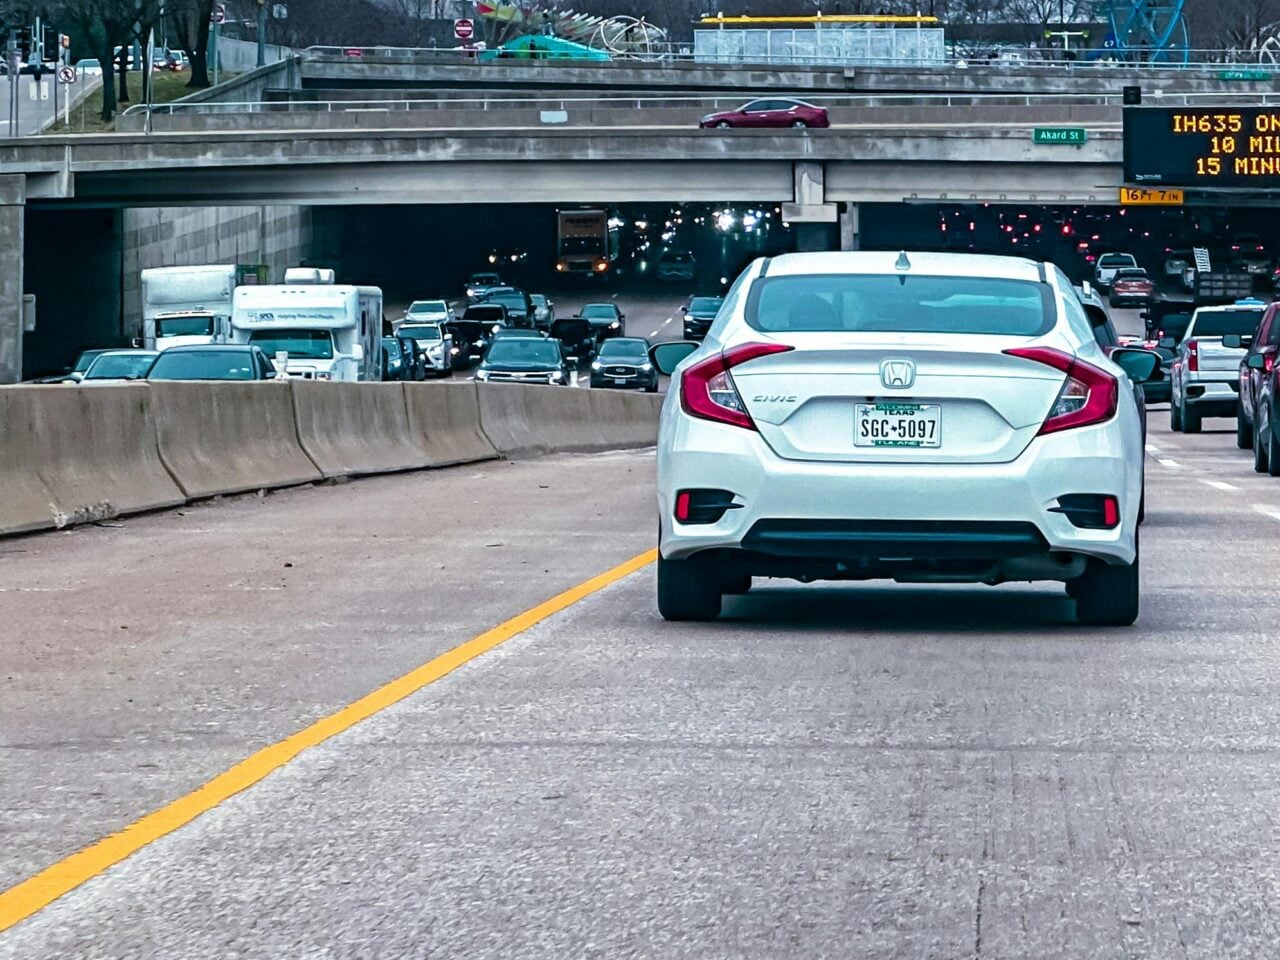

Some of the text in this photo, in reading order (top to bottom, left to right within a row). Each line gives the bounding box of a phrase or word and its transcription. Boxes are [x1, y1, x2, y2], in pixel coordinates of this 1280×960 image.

[1173, 114, 1242, 132] IH635
[1040, 131, 1079, 140] Akard St
[1211, 136, 1235, 153] 10
[1196, 158, 1221, 175] 15
[752, 395, 798, 403] CIVIC
